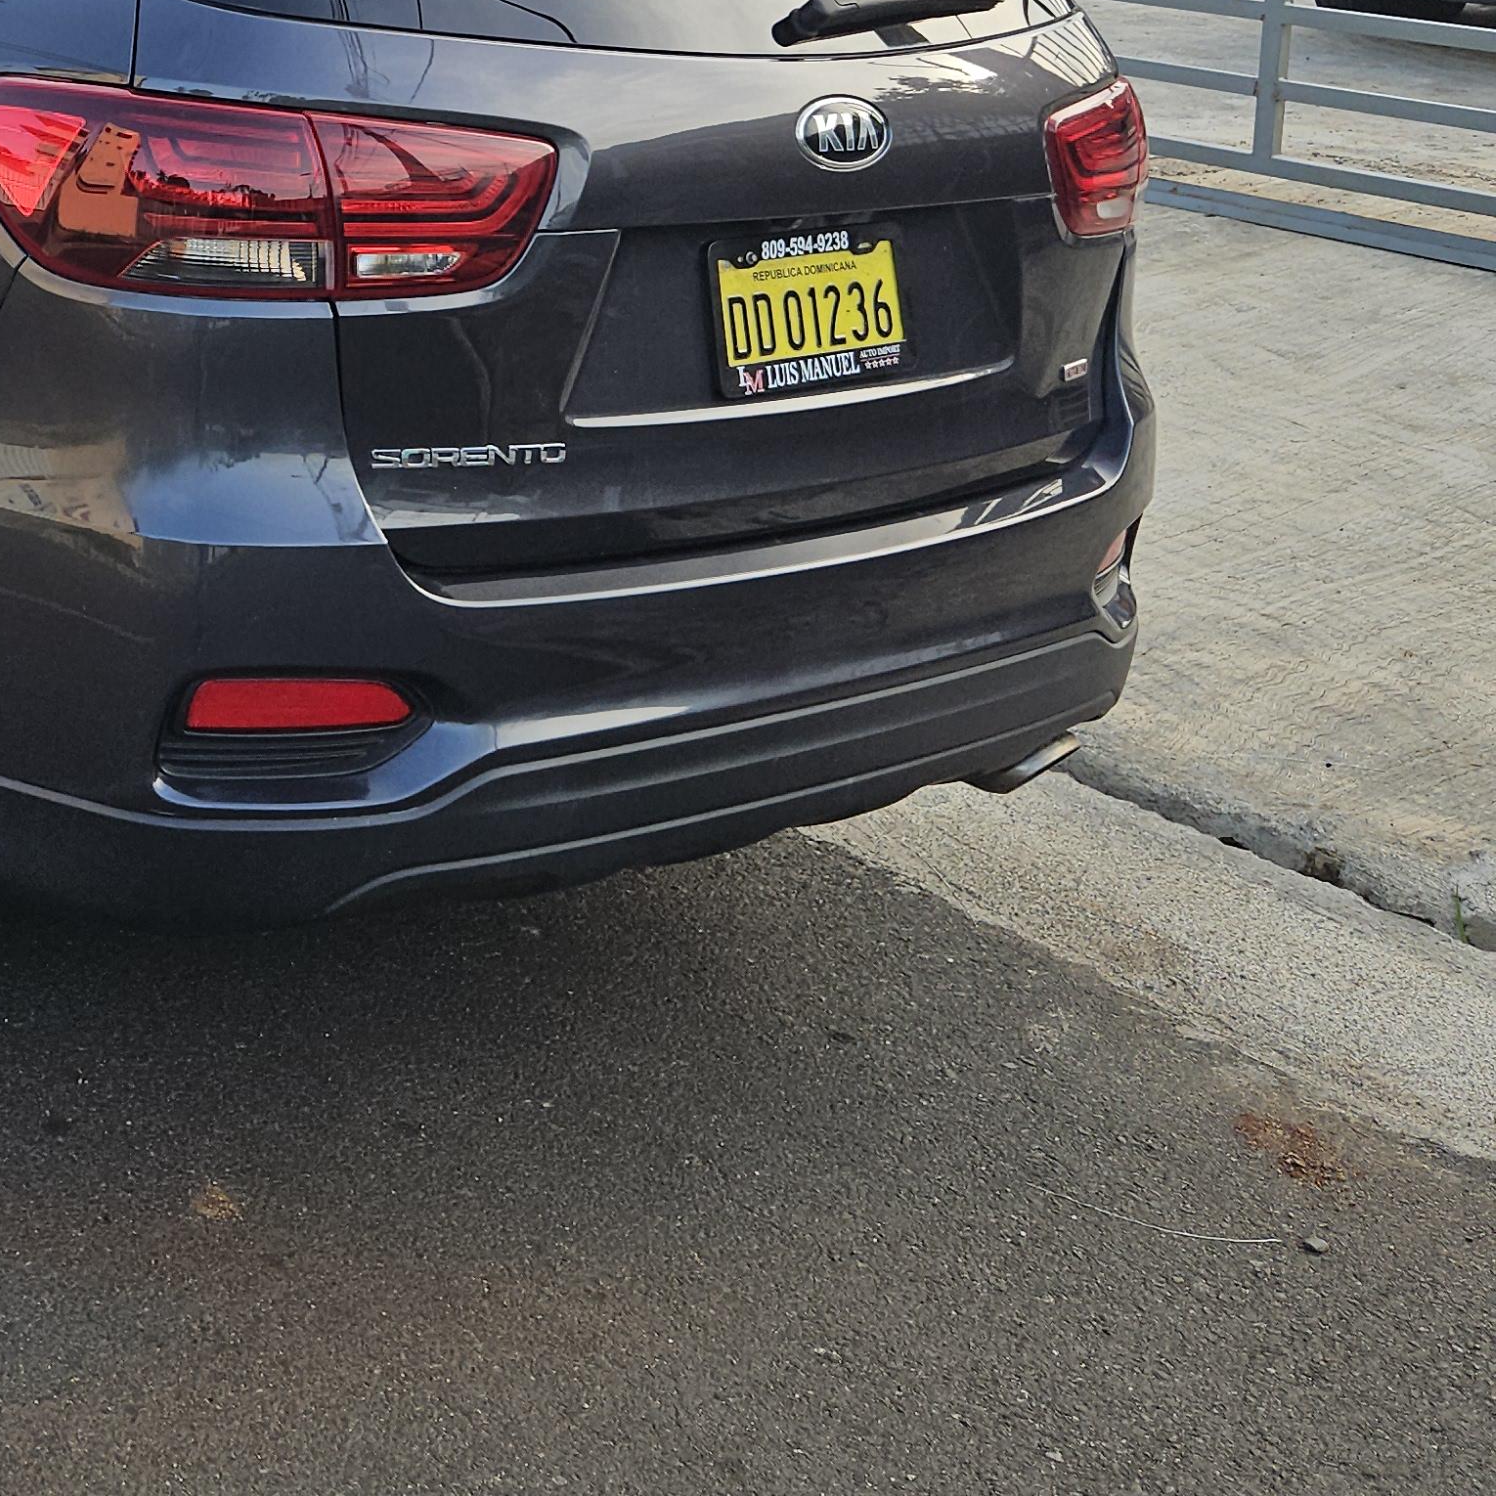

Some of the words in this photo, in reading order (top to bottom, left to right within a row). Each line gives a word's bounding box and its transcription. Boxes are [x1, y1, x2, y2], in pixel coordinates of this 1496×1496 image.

[812, 111, 878, 153] KIA
[761, 230, 849, 260] 809-594-9238
[752, 267, 803, 282] REPUBLICA
[804, 260, 857, 276] DOMINICANA
[767, 359, 800, 389] LUIS
[800, 352, 860, 384] MANUEL
[371, 442, 566, 470] SORENTO
